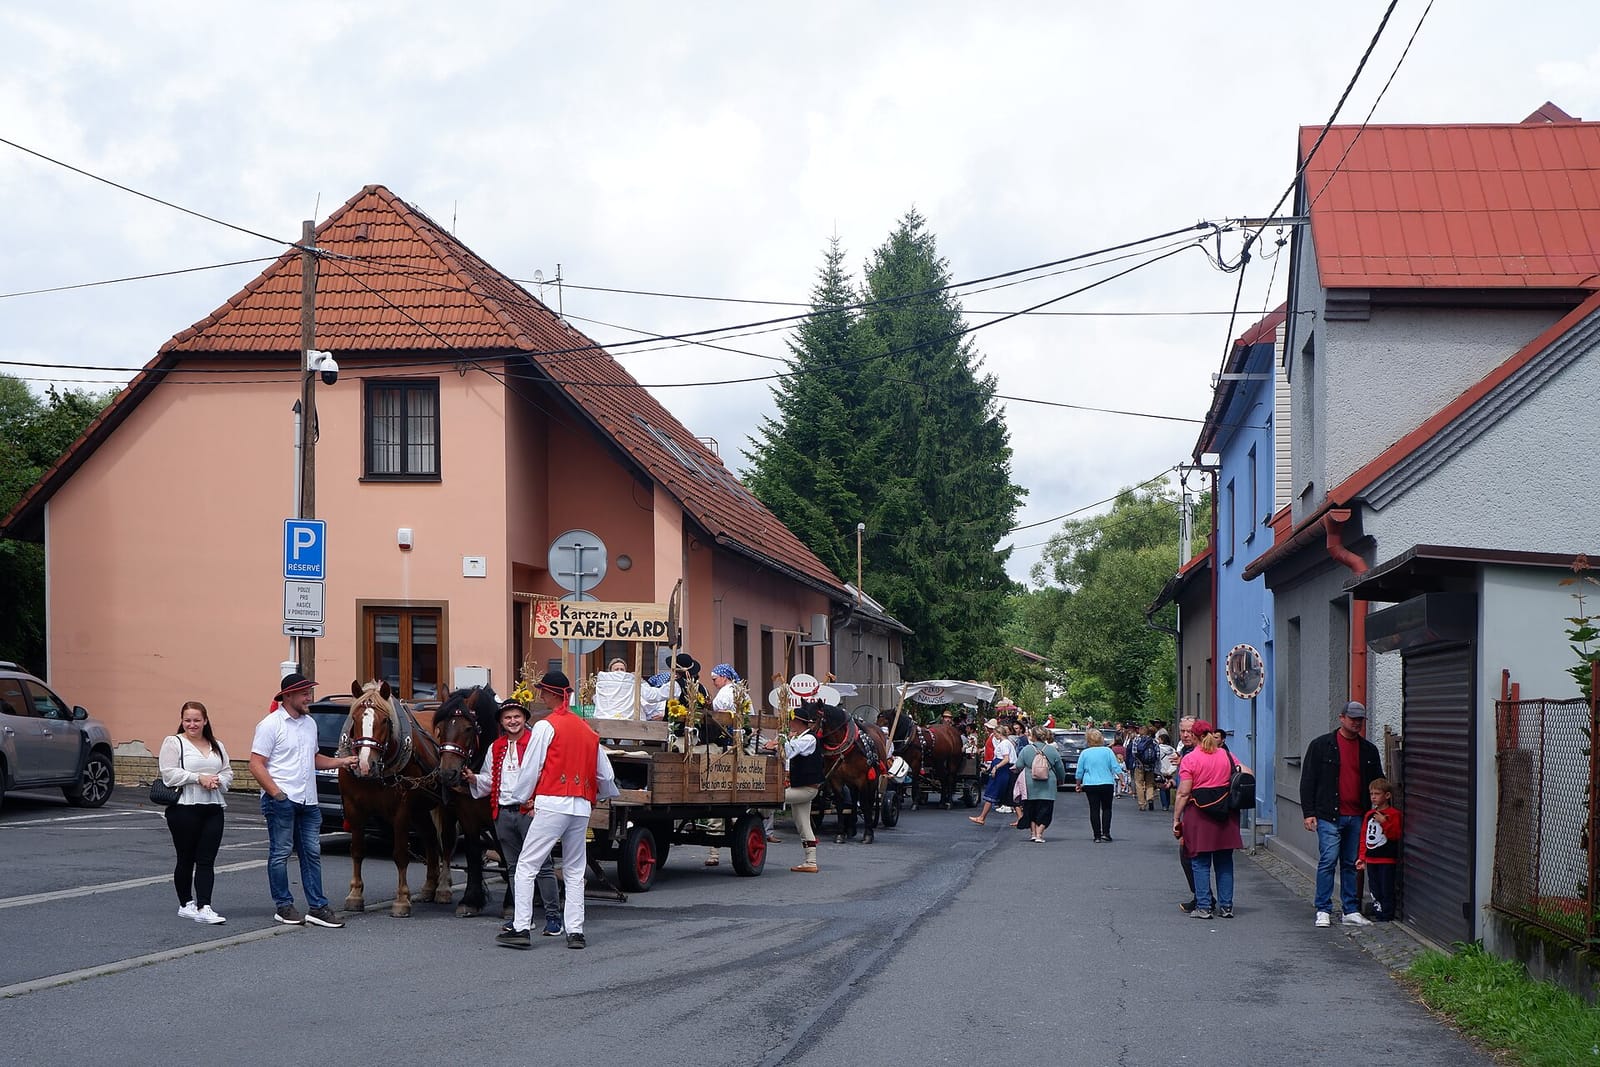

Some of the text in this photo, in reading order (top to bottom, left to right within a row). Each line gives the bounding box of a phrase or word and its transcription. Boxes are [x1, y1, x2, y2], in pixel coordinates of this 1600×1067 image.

[293, 527, 316, 560] P
[288, 563, 321, 572] RÉSERVÉ
[560, 603, 632, 621] Karczma u
[550, 621, 613, 638] STAREJ
[917, 694, 946, 704] NAWSIE
